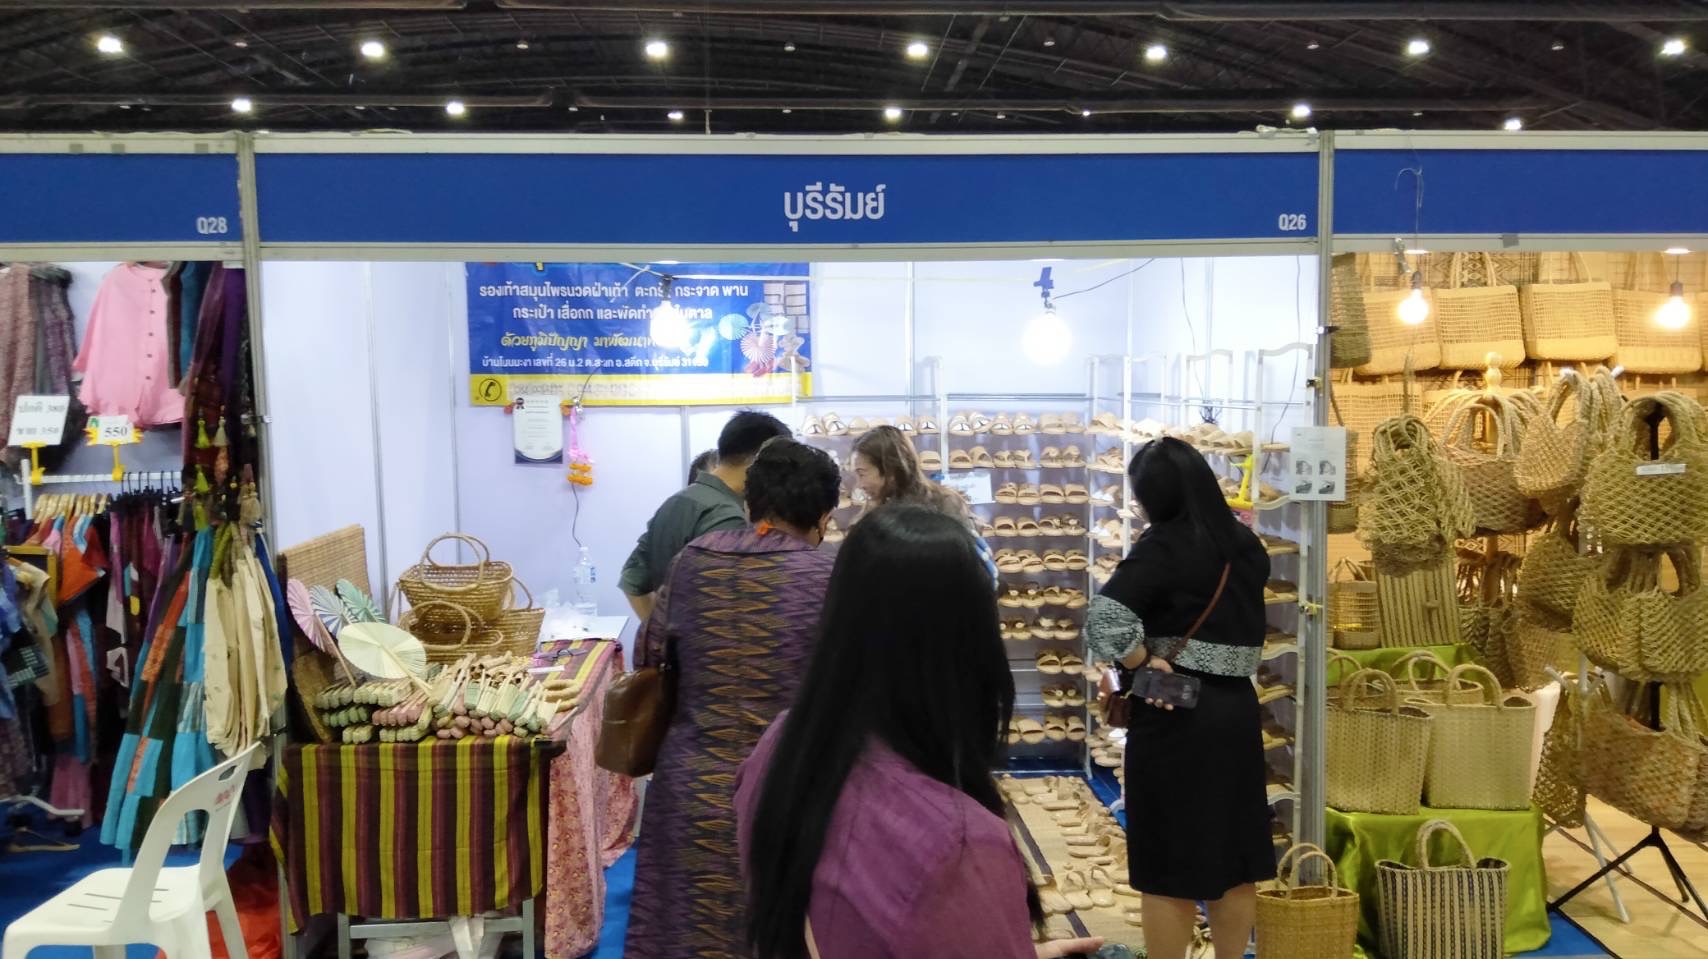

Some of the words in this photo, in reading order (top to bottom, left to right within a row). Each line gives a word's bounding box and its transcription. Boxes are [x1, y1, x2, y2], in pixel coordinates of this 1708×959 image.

[784, 181, 887, 232] บุรีรัมย์
[197, 216, 228, 234] Q28
[1279, 213, 1307, 231] Q26
[674, 285, 719, 297] กระจาด
[722, 285, 749, 297] พาน
[513, 303, 555, 319] กระเป๋า
[555, 358, 567, 367] 26
[104, 426, 128, 438] 550
